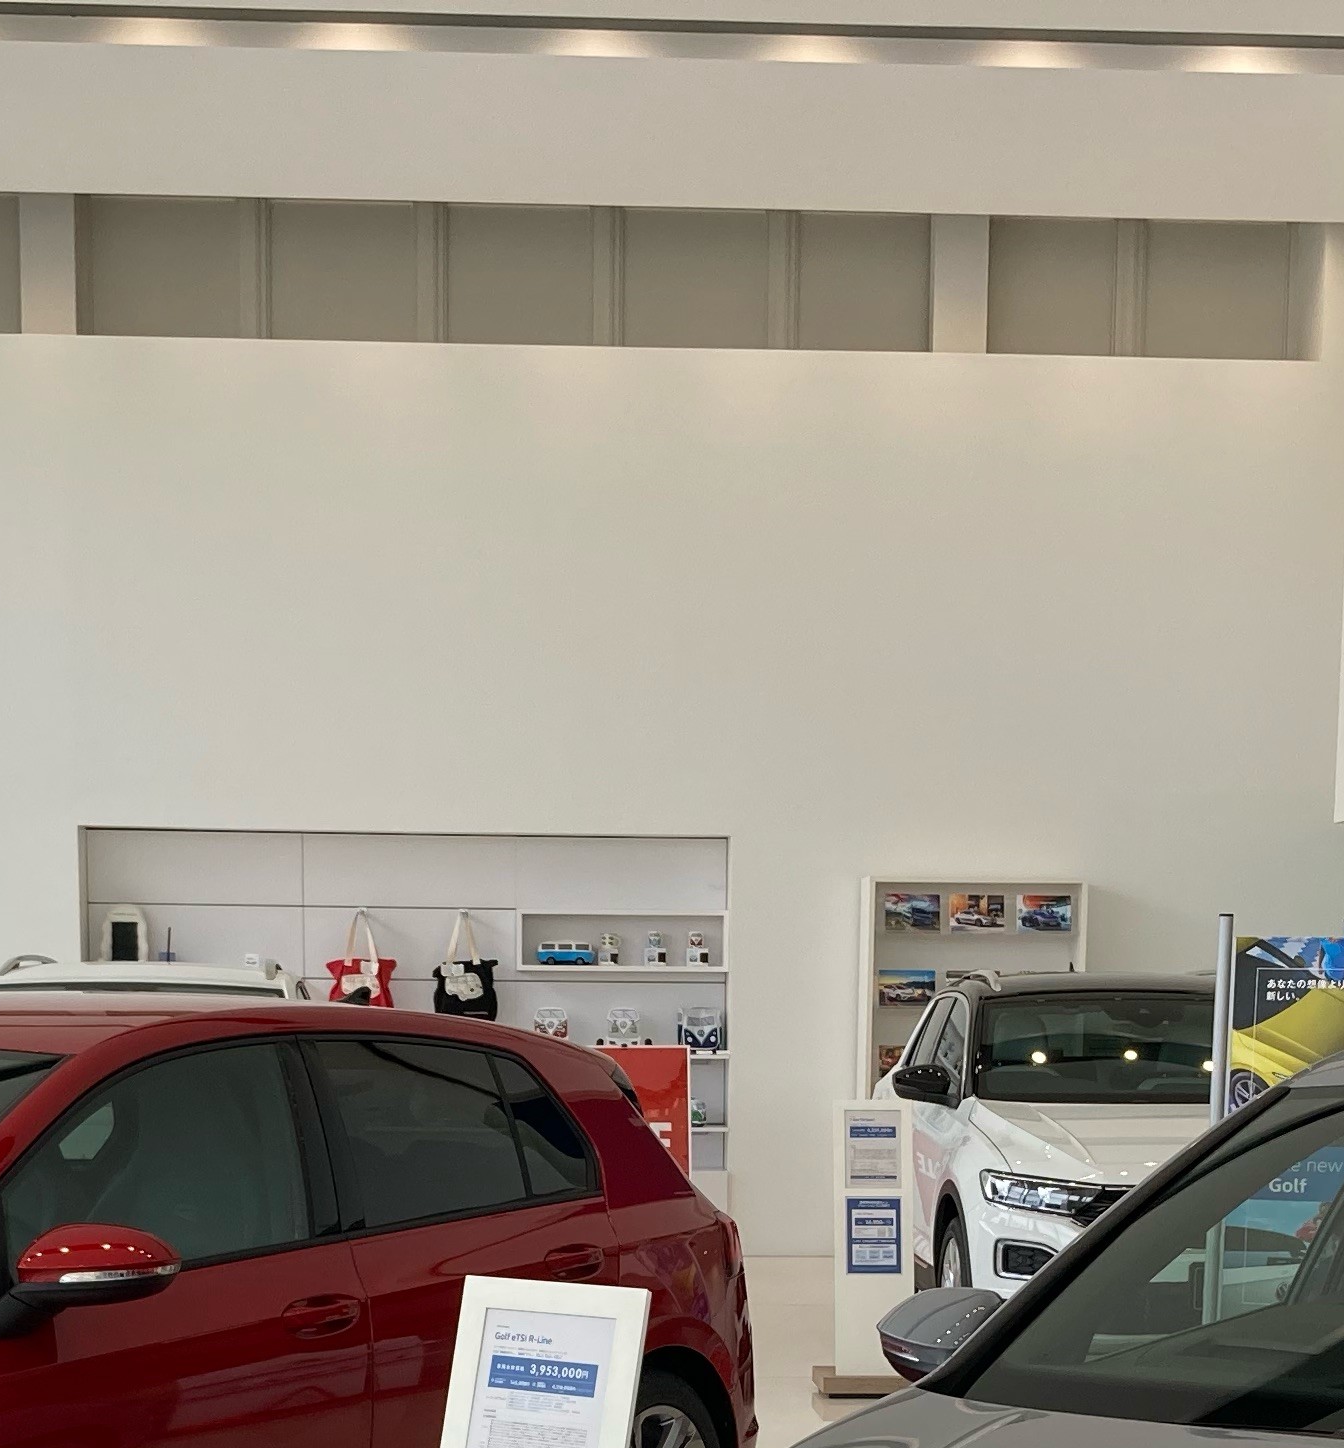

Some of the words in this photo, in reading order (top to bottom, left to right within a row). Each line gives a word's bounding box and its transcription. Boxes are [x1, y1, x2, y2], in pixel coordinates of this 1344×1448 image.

[1266, 991, 1300, 1001] 新しい。
[1306, 1160, 1344, 1173] new
[1268, 1177, 1307, 1193] Golf
[494, 1331, 510, 1341] Golf
[528, 1334, 552, 1345] R-Line
[529, 1363, 589, 1379] 3,953,000円
